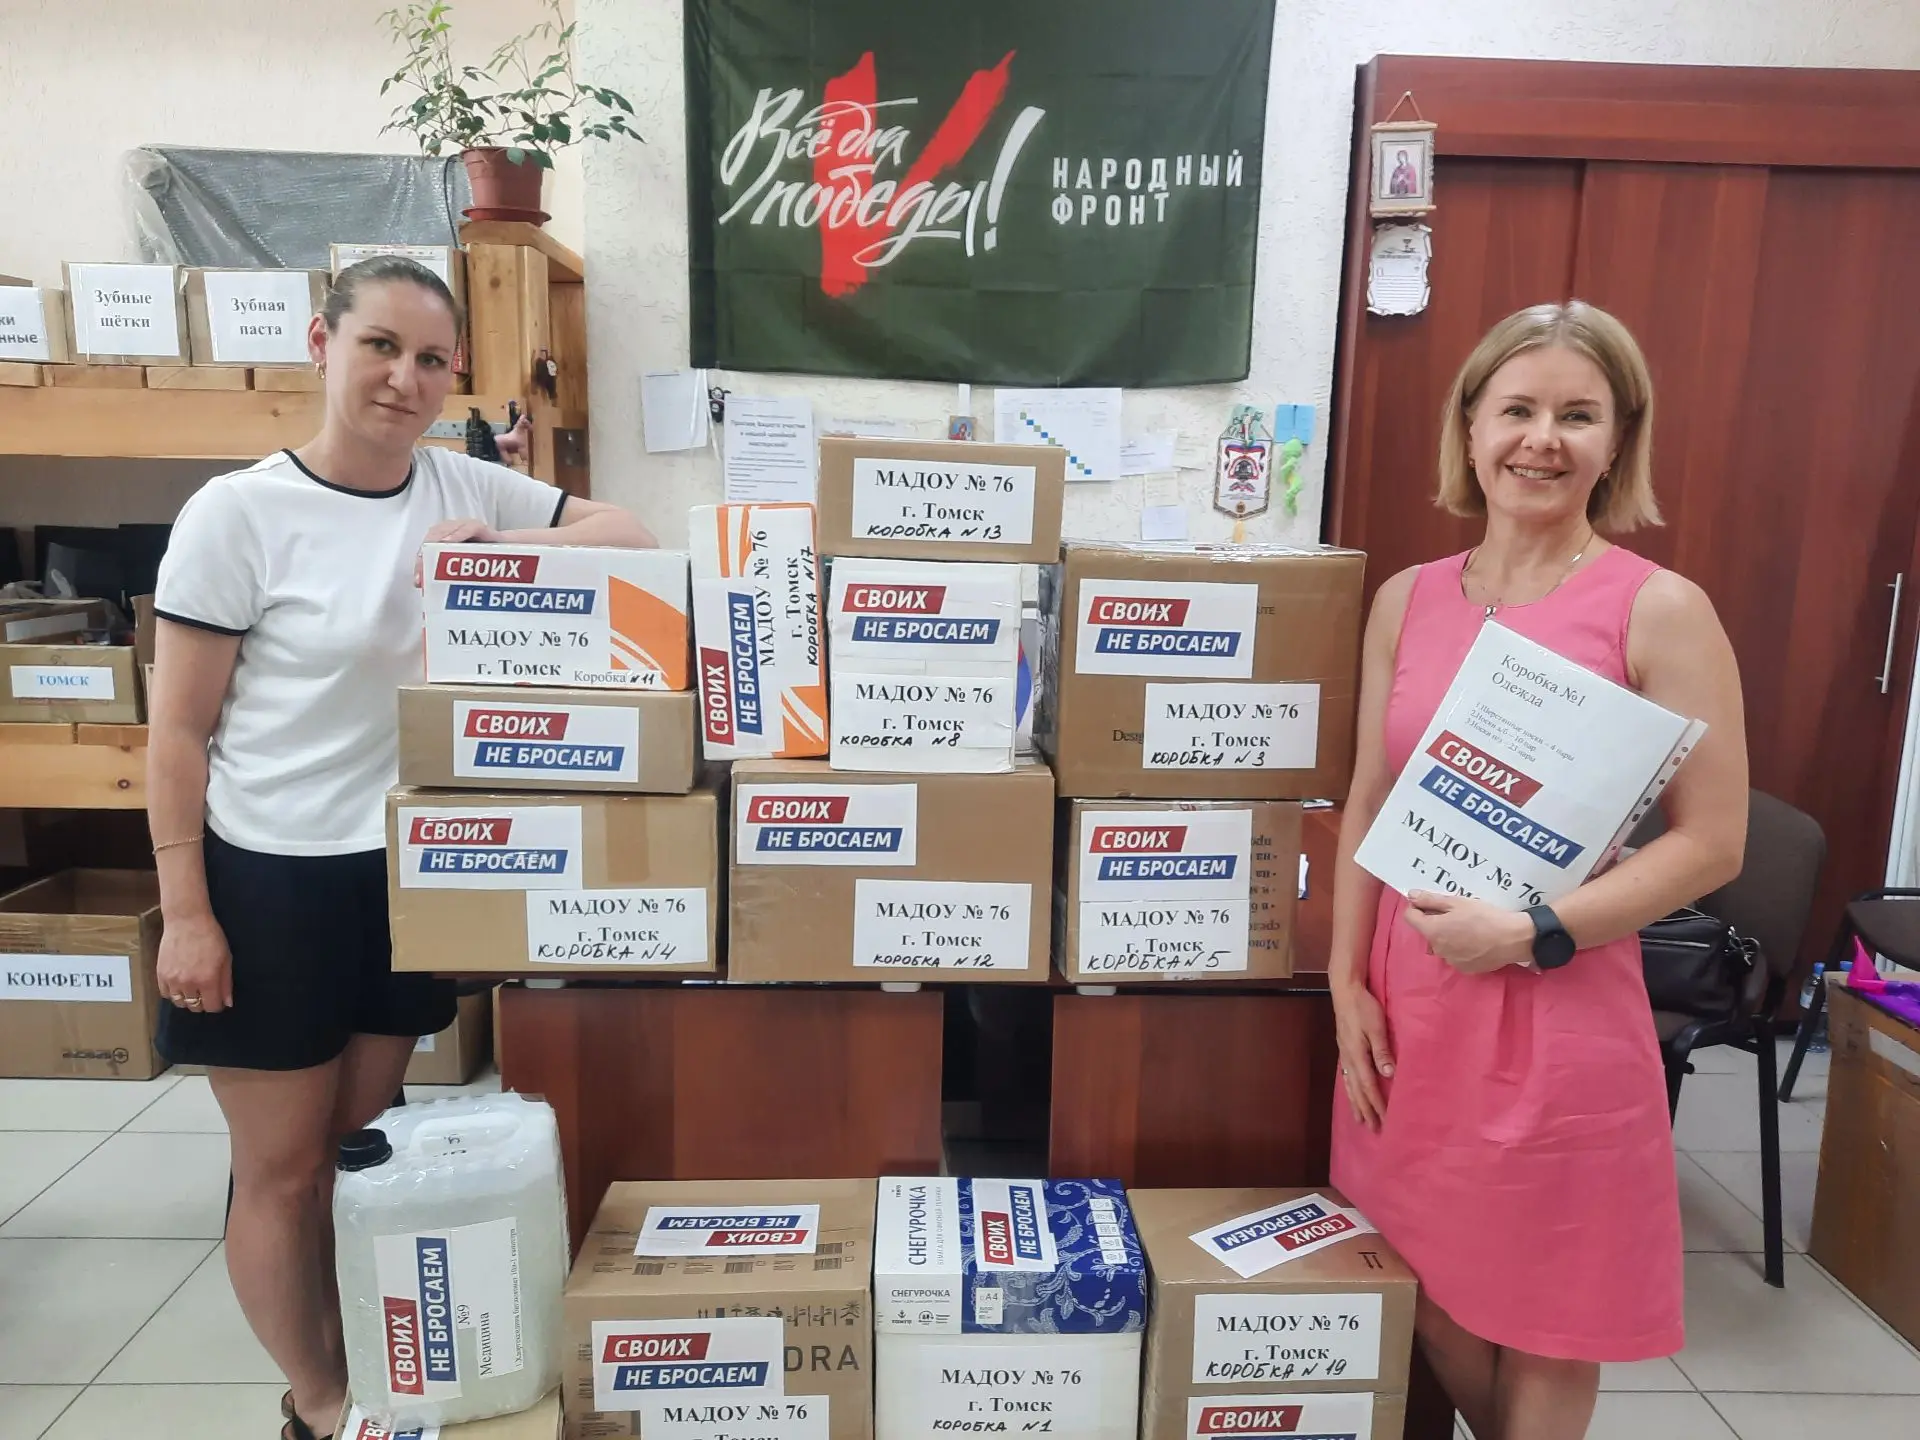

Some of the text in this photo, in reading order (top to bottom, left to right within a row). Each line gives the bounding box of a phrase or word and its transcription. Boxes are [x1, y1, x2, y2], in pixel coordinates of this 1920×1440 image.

[719, 87, 918, 225] Всё для
[1052, 149, 1244, 191] НАРОДНЫЙ
[751, 106, 1046, 267] победы!
[1052, 191, 1171, 226] ФРОНТ
[94, 289, 152, 306] Зубные
[231, 298, 285, 313] Зубная
[100, 315, 150, 328] щётки
[240, 325, 282, 336] паста
[874, 470, 1014, 493] МАДОУ № 76
[902, 503, 985, 521] г. Томск
[867, 524, 951, 538] КОРОБКА
[445, 557, 522, 579] СВОИХ
[457, 589, 585, 611] НЕ БРОСАЕМ
[751, 530, 777, 667] МАДОУ № 76
[786, 557, 803, 638] г. Томск
[853, 589, 929, 609] СВОИХ
[1099, 601, 1173, 622] СВОИХ
[448, 629, 588, 648] МАДОУ № 76
[863, 621, 989, 640] НЕ БРОСАЕМ
[1106, 632, 1230, 653] НЕ БРОСАЕМ
[477, 659, 562, 676] г. Томск
[733, 602, 758, 725] НЕ БРОСАЕМ
[37, 675, 89, 686] ТОМСК
[574, 670, 626, 684] Коробка
[1501, 654, 1559, 694] Коробка
[856, 684, 993, 704] МАДОУ № 76
[1492, 671, 1544, 708] Одежда
[706, 664, 729, 735] СВОИХ
[1165, 703, 1299, 721] МАДОУ № 76
[475, 715, 553, 736] СВОИХ
[882, 714, 965, 731] г. Томск
[840, 735, 913, 746] КОРОБКА
[1191, 732, 1271, 748] г. Томск
[485, 746, 614, 767] НЕ БРОСАЕМ
[1150, 751, 1224, 765] КОРОБКА
[1439, 741, 1522, 796] СВОИХ
[757, 800, 831, 820] СВОИХ
[1432, 775, 1569, 861] НЕ БРОСАЕМ
[420, 822, 494, 841] СВОИХ
[767, 831, 892, 848] НЕ БРОСАЕМ
[1100, 830, 1171, 849] СВОИХ
[430, 852, 557, 870] НЕ БРОСАЕМ
[1401, 810, 1547, 906] МАДОУ № 76
[1411, 857, 1426, 874] г.
[1108, 859, 1227, 877] НЕ БРОСАЕМ
[549, 899, 686, 916] МАДОУ № 76
[876, 902, 1010, 921] МАДОУ № 76
[1100, 908, 1230, 928] МАДОУ № 76
[577, 927, 660, 942] г. Томск
[901, 931, 982, 947] г. Томск
[537, 943, 634, 961] КОРОБКА
[1126, 938, 1204, 954] г. Томск
[873, 954, 940, 968] КОРОБКА
[1086, 953, 1181, 970] КОРОБКА
[7, 972, 114, 988] КОНФЕТЫ
[668, 1216, 790, 1228] НЕ БРОСАЕМ
[908, 1185, 927, 1266] СНЕГУРОЧКА
[1015, 1190, 1036, 1255] НЕ БРОСАЕМ
[1221, 1207, 1318, 1247] НЕ БРОСАЕМ
[1287, 1218, 1347, 1244] СВОИХ
[724, 1232, 797, 1244] СВОИХ
[989, 1219, 1008, 1260] СВОИХ
[891, 1289, 950, 1298] СНЕГУРОЧКА
[422, 1247, 450, 1372] НЕ БРОСАЕМ
[457, 1304, 471, 1326] №9
[1216, 1314, 1359, 1333] МАДОУ № 76
[391, 1314, 417, 1386] СВОИХ
[479, 1311, 493, 1376] Медицина
[614, 1339, 692, 1358] СВОИХ
[1244, 1344, 1330, 1361] г. Томск
[625, 1366, 757, 1386] НЕ БРОСАЕМ
[940, 1369, 1082, 1386] МАДОУ № 76
[664, 1404, 807, 1423] МАДОУ № 76
[968, 1398, 1053, 1412] г. Томск
[932, 1419, 1007, 1432] КОРОБКА
[1208, 1411, 1285, 1429] СВОИХ
